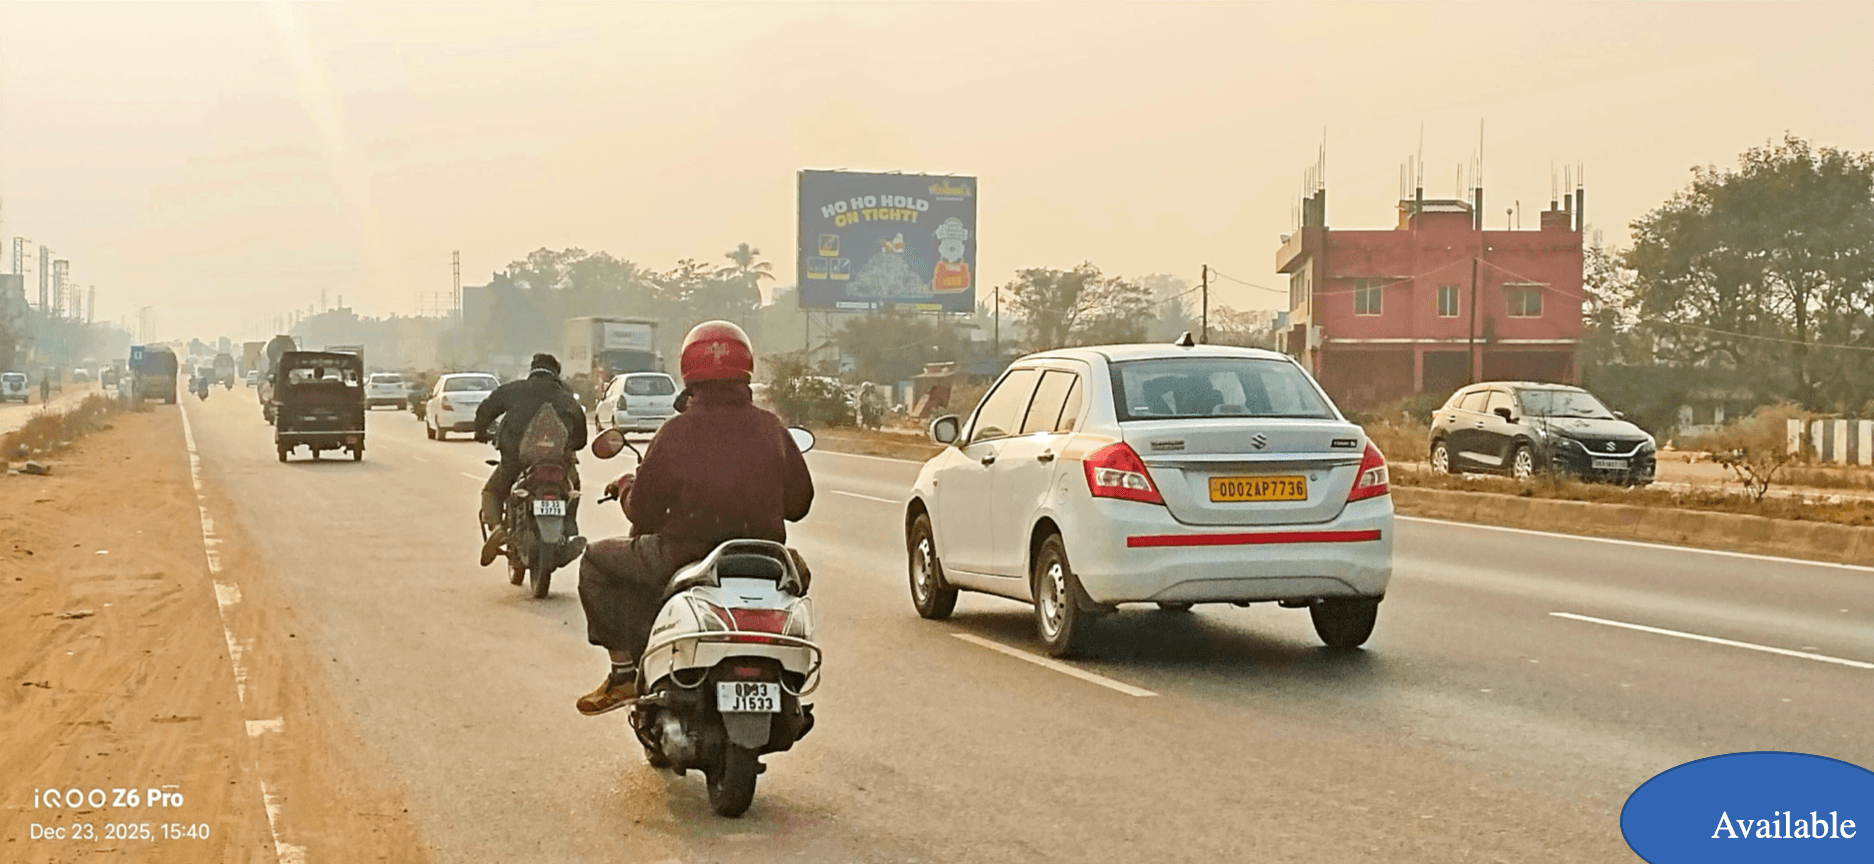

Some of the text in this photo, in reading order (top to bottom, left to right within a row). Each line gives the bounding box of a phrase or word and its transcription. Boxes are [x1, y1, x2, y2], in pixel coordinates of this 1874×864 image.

[821, 195, 929, 218] HO HO HOLD
[834, 209, 919, 227] ON TIGHT!
[1220, 481, 1303, 497] OD02AP7736
[732, 697, 773, 710] J1533
